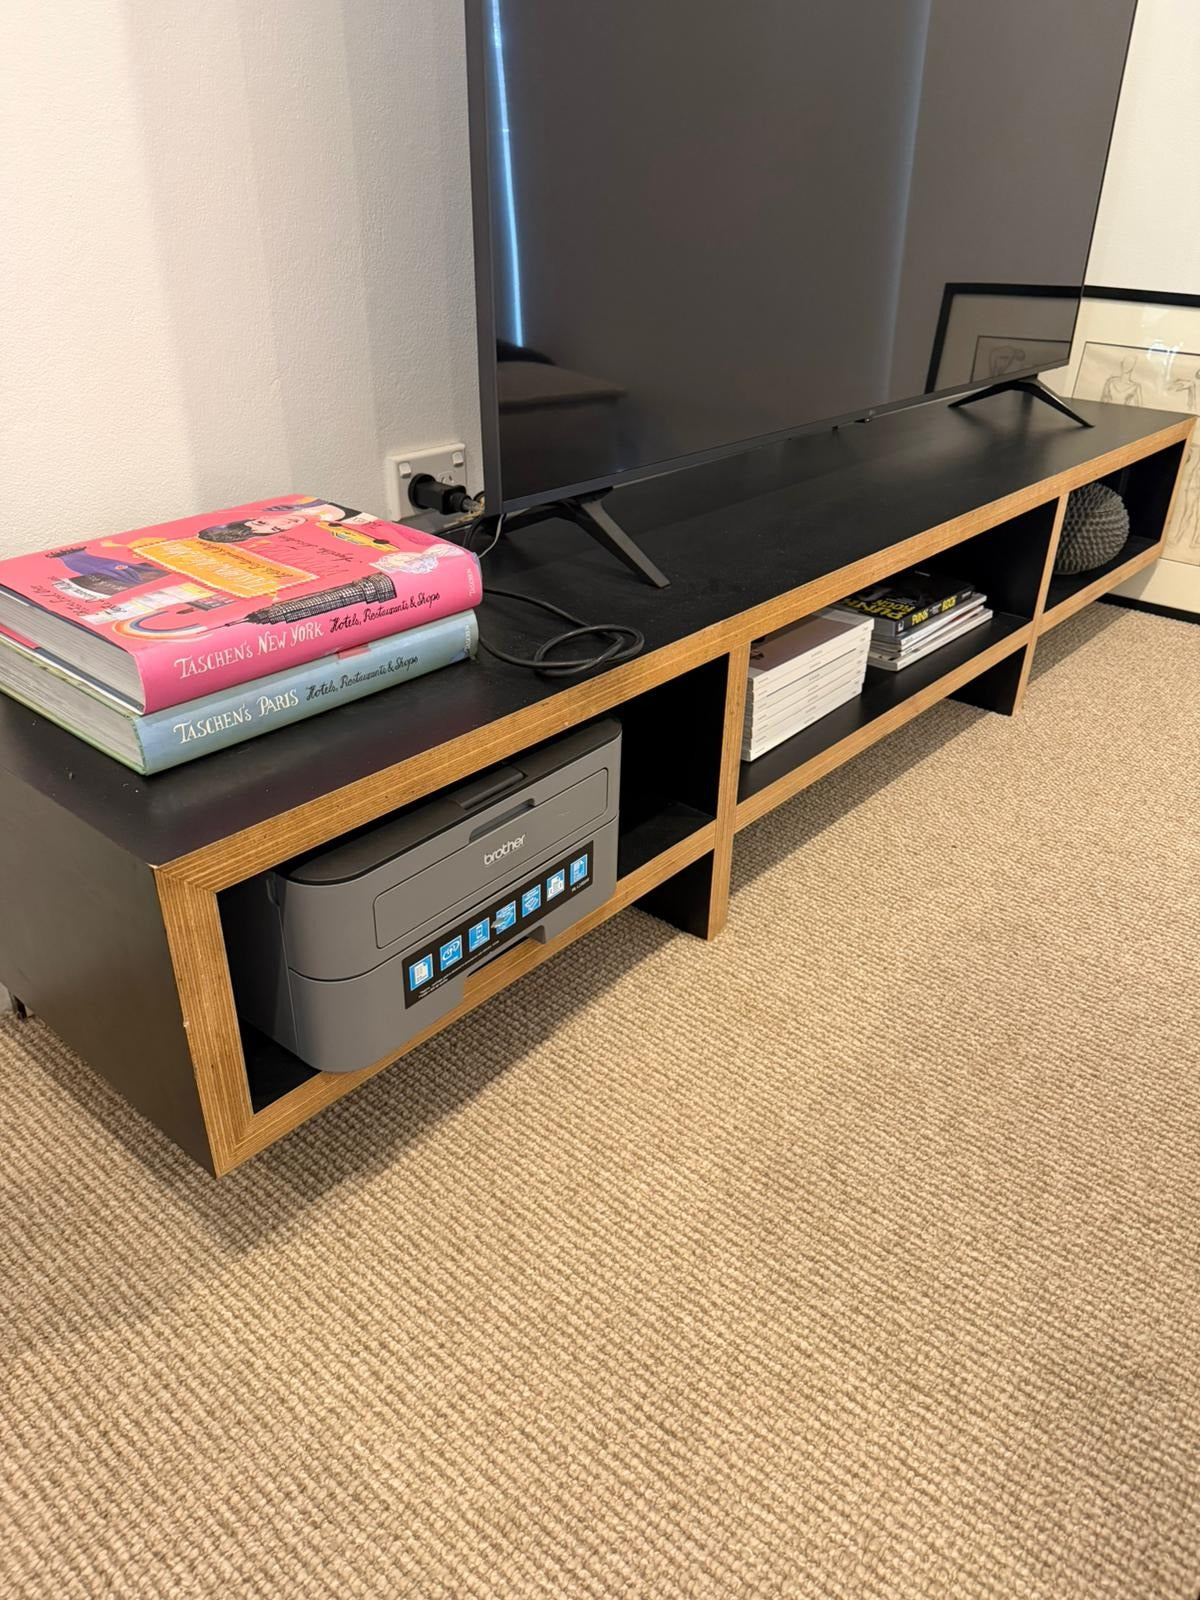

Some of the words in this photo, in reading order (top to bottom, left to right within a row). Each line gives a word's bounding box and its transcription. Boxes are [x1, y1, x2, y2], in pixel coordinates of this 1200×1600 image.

[257, 631, 286, 655] NEW
[290, 621, 325, 647] YORK
[329, 614, 362, 633] Hotels,
[363, 602, 409, 623] Restaurants
[408, 597, 417, 608] &
[416, 592, 441, 610] Shops
[256, 689, 299, 717] PARIS
[306, 679, 339, 701] Hotels,
[340, 665, 387, 691] Restaurants
[386, 660, 395, 672] &
[394, 655, 419, 675] Shops
[483, 833, 526, 866] brother
